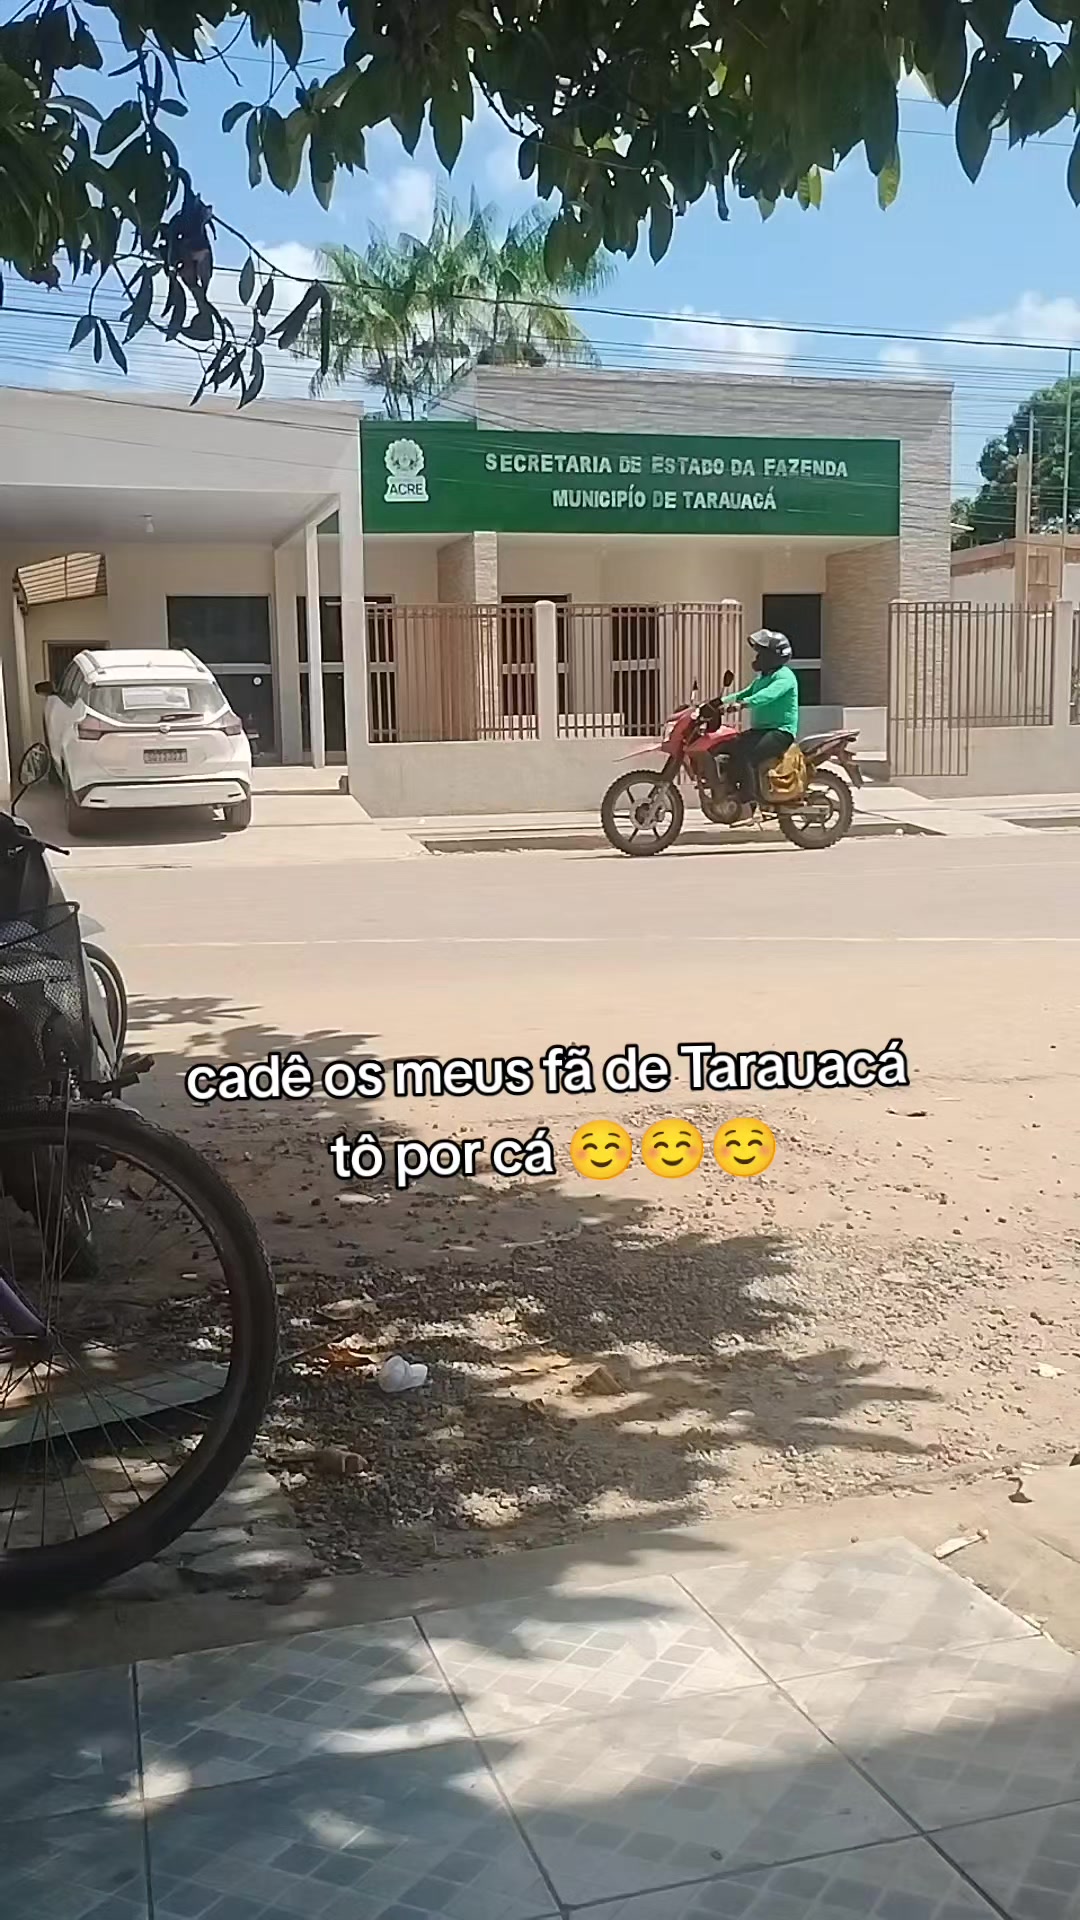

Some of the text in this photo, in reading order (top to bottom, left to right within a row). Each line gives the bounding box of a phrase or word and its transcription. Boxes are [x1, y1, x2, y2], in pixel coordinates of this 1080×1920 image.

[485, 453, 848, 477] SECRETARIA DE ESTADO DA FAZENDA
[390, 483, 423, 495] ACRE
[652, 491, 677, 509] DE
[683, 486, 777, 510] TARAUACÁ
